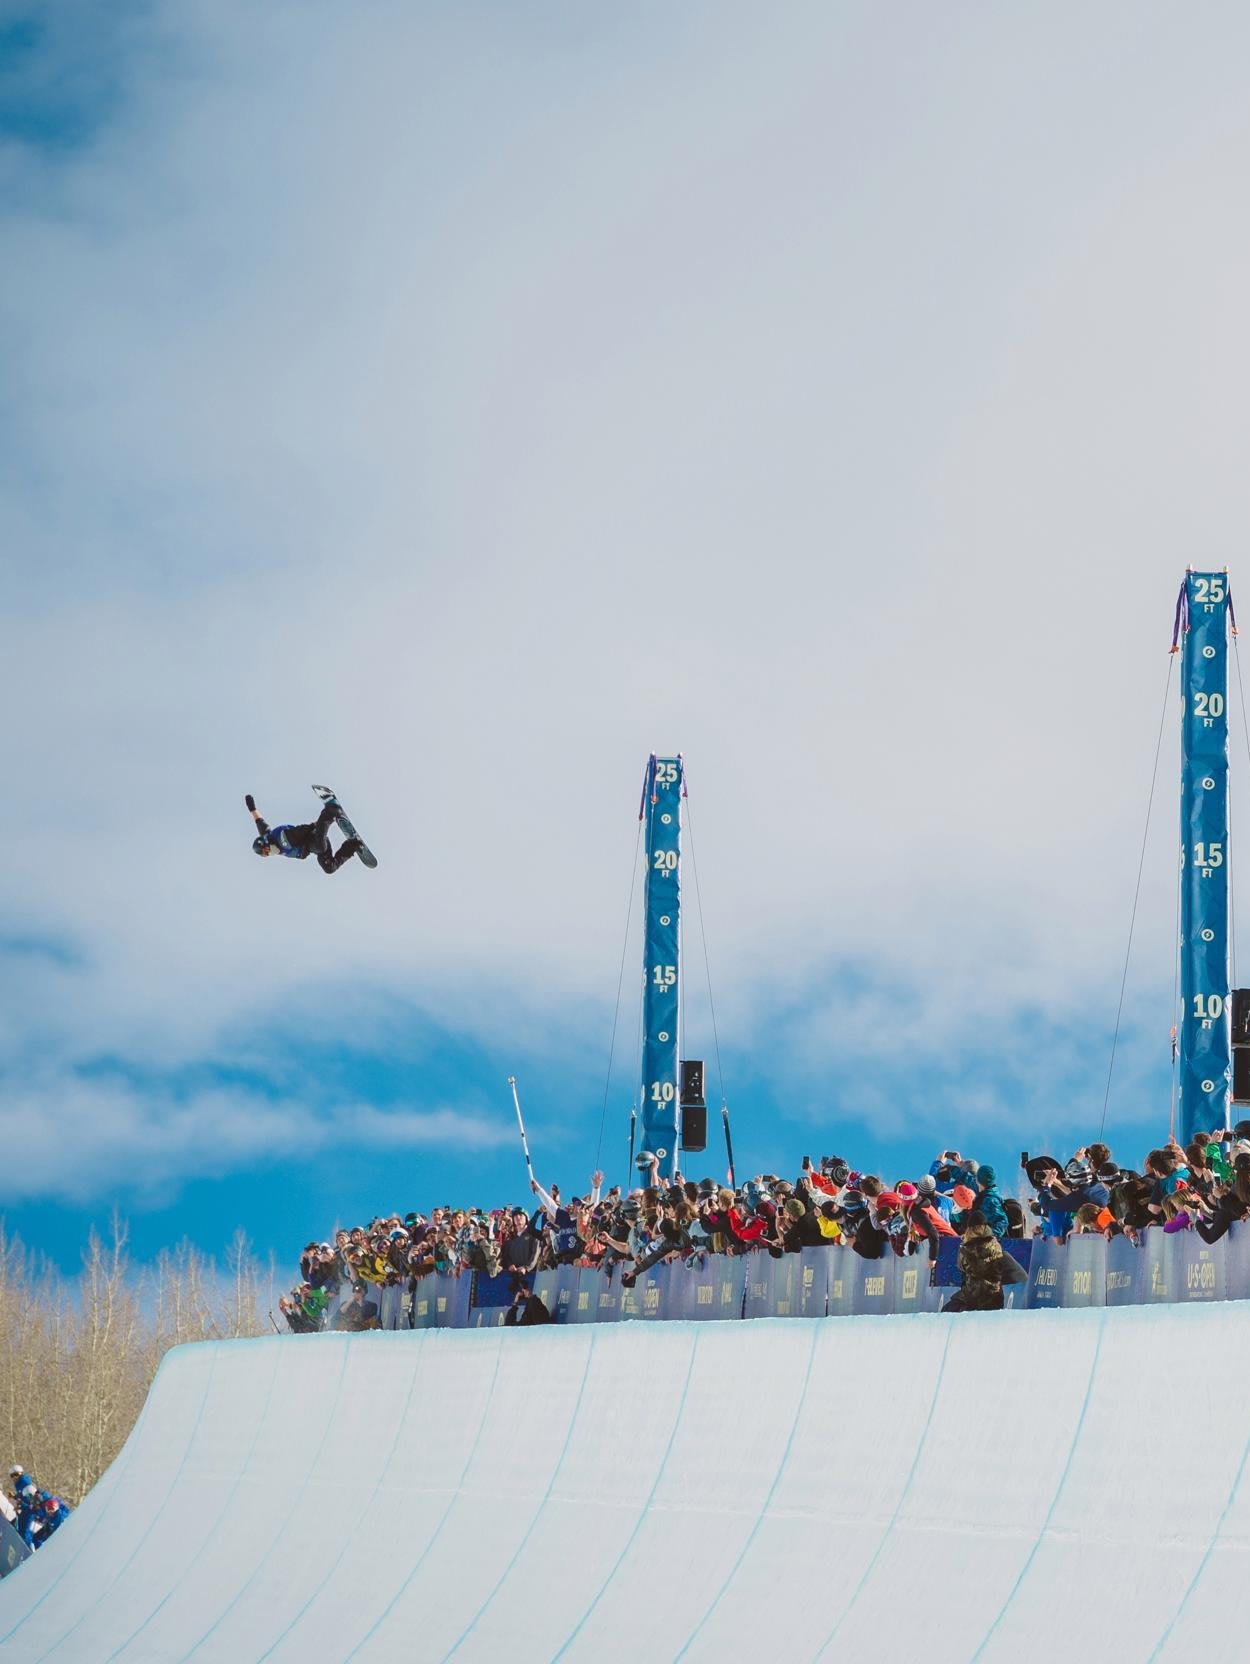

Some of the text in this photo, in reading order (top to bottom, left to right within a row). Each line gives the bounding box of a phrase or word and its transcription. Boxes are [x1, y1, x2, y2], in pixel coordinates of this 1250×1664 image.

[1194, 578, 1224, 603] 25
[1203, 604, 1215, 613] FT
[1194, 692, 1224, 718] 20
[1203, 718, 1214, 728] FT
[655, 763, 678, 783] 25
[661, 783, 670, 791] FT
[654, 850, 678, 870] 20
[1193, 842, 1223, 868] 15
[661, 870, 670, 878] FT
[1202, 868, 1213, 878] FT
[653, 965, 676, 985] 15
[659, 985, 668, 993] FT
[1193, 993, 1223, 1019] 10
[1201, 1019, 1213, 1030] FT
[651, 1081, 674, 1102] 10
[657, 1102, 667, 1110] FT
[568, 1235, 578, 1249] 3
